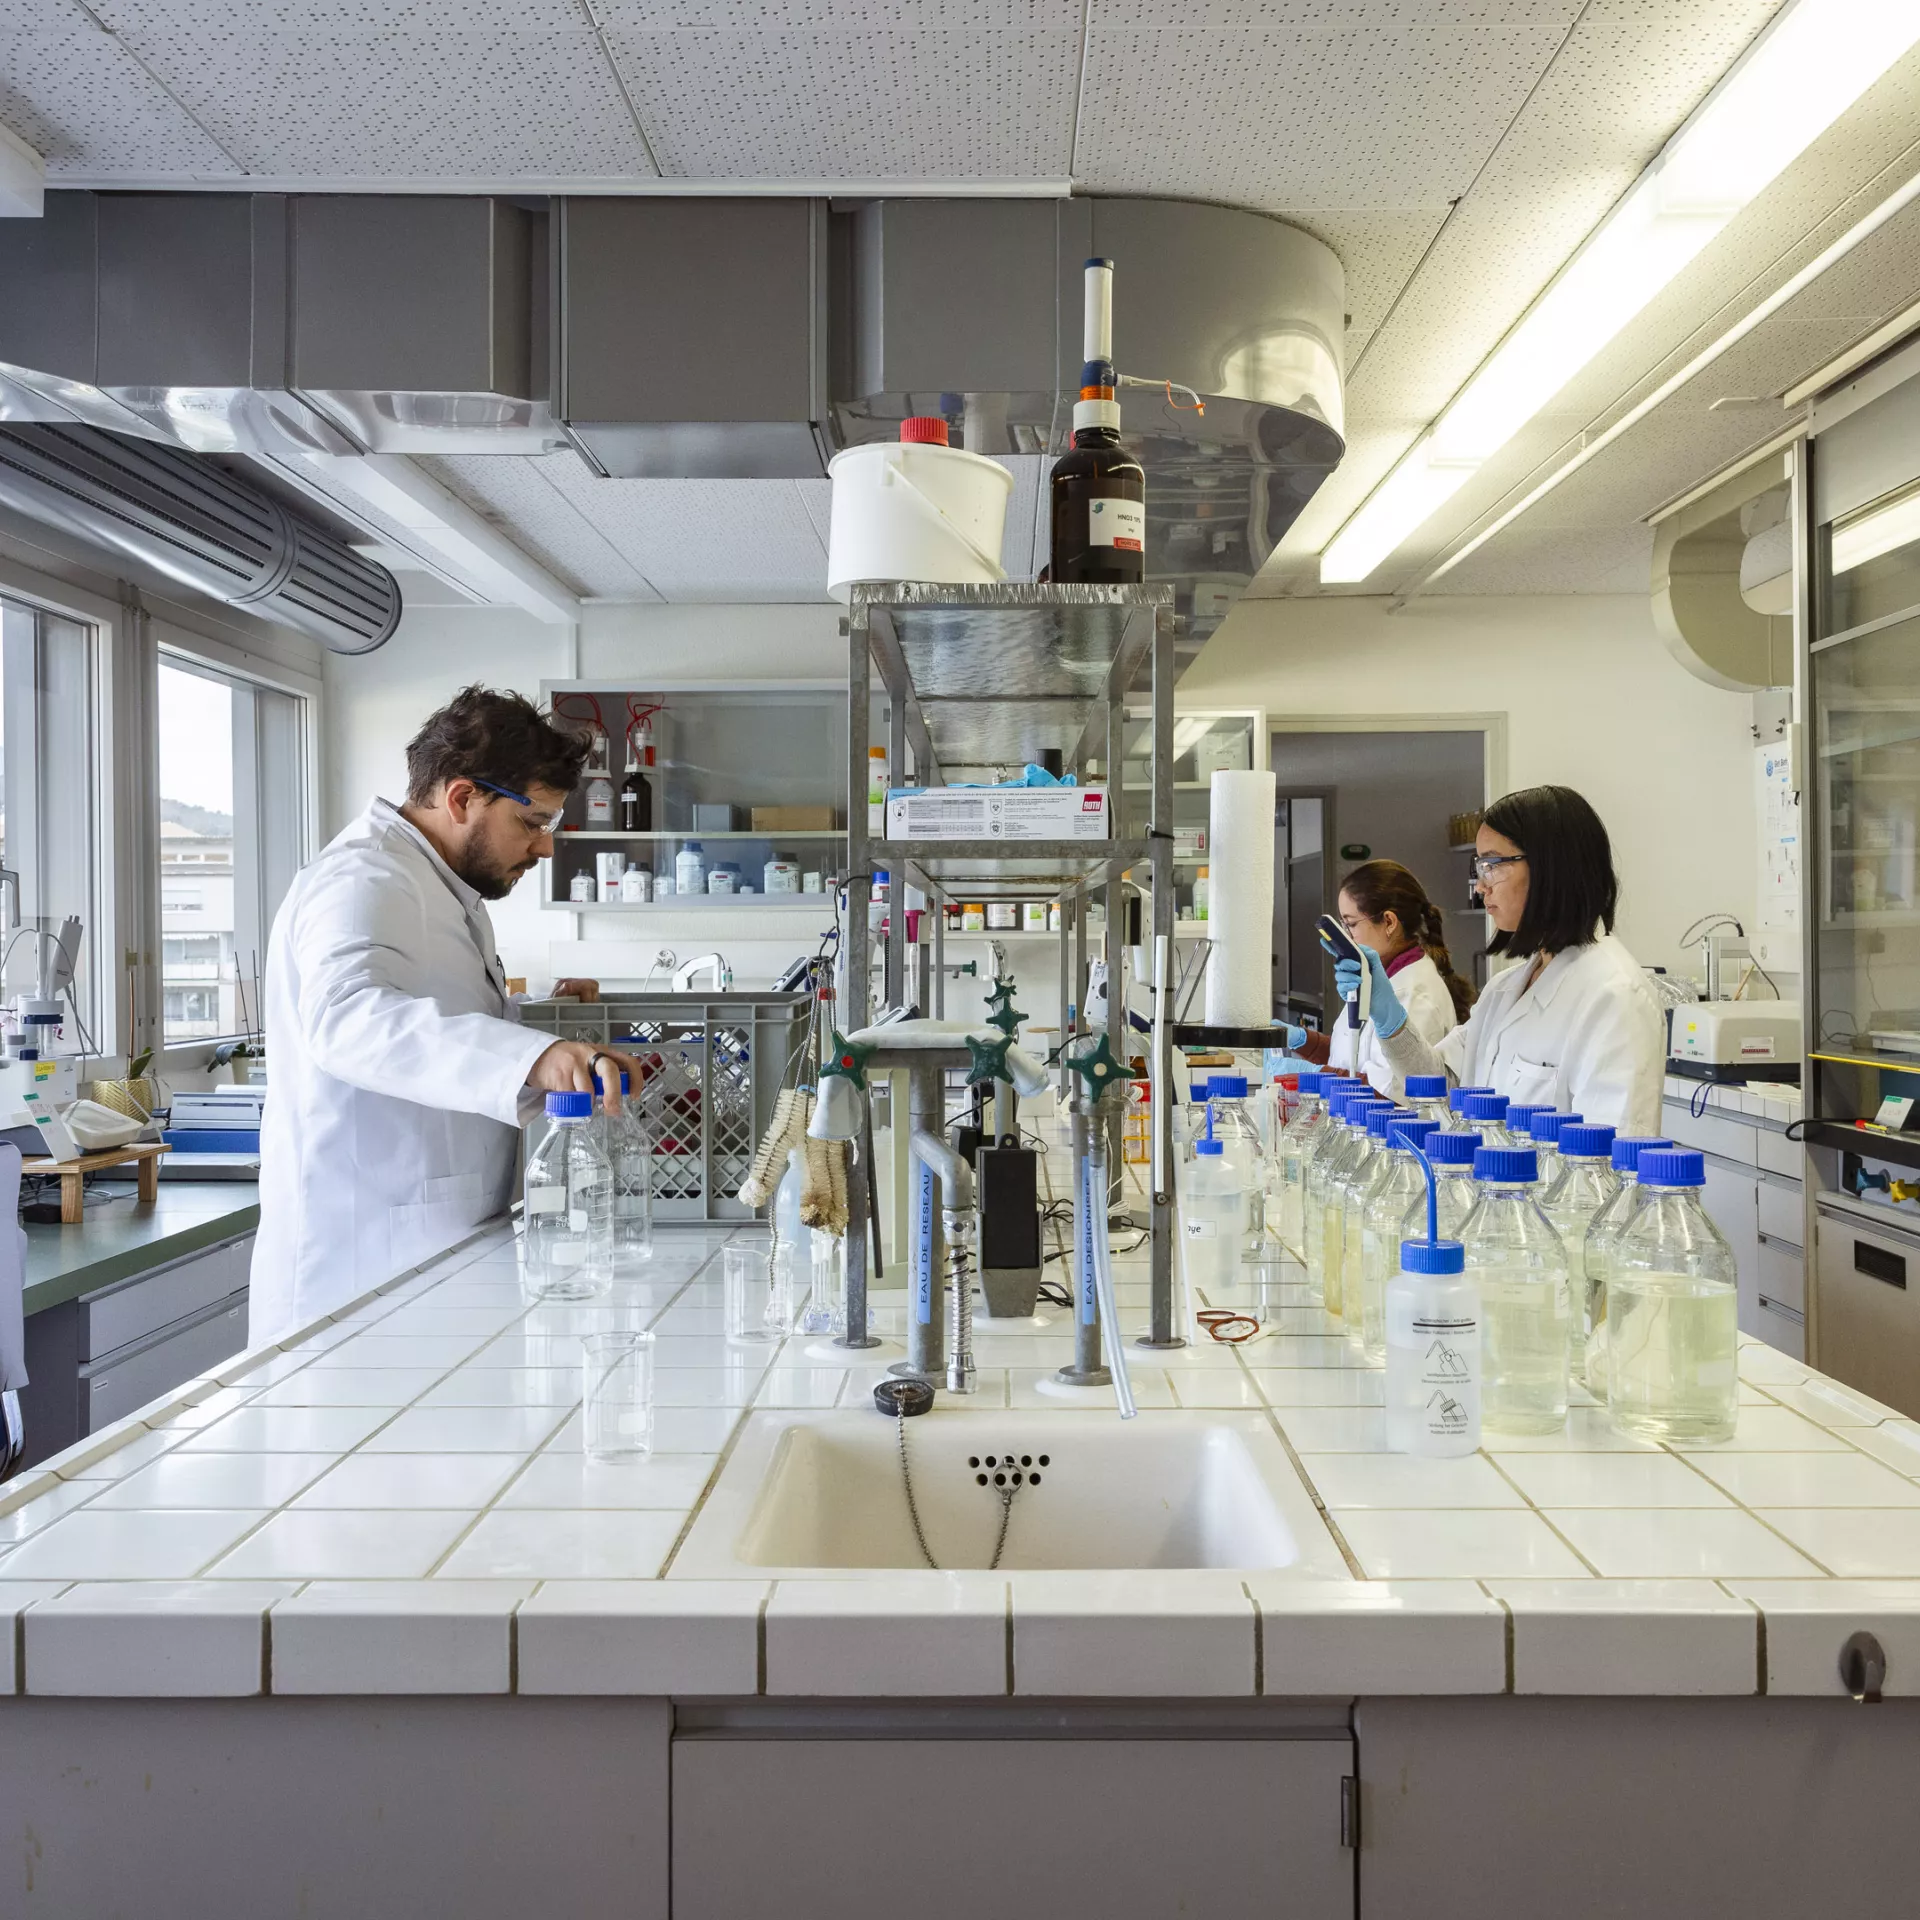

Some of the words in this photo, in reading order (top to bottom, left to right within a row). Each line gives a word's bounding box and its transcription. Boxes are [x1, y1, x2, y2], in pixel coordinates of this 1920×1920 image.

[1083, 801, 1101, 810] ROTH
[922, 1174, 931, 1234] RESEAU
[921, 1243, 928, 1263] DE
[920, 1271, 928, 1303] EAU
[1085, 1273, 1093, 1305] EAU
